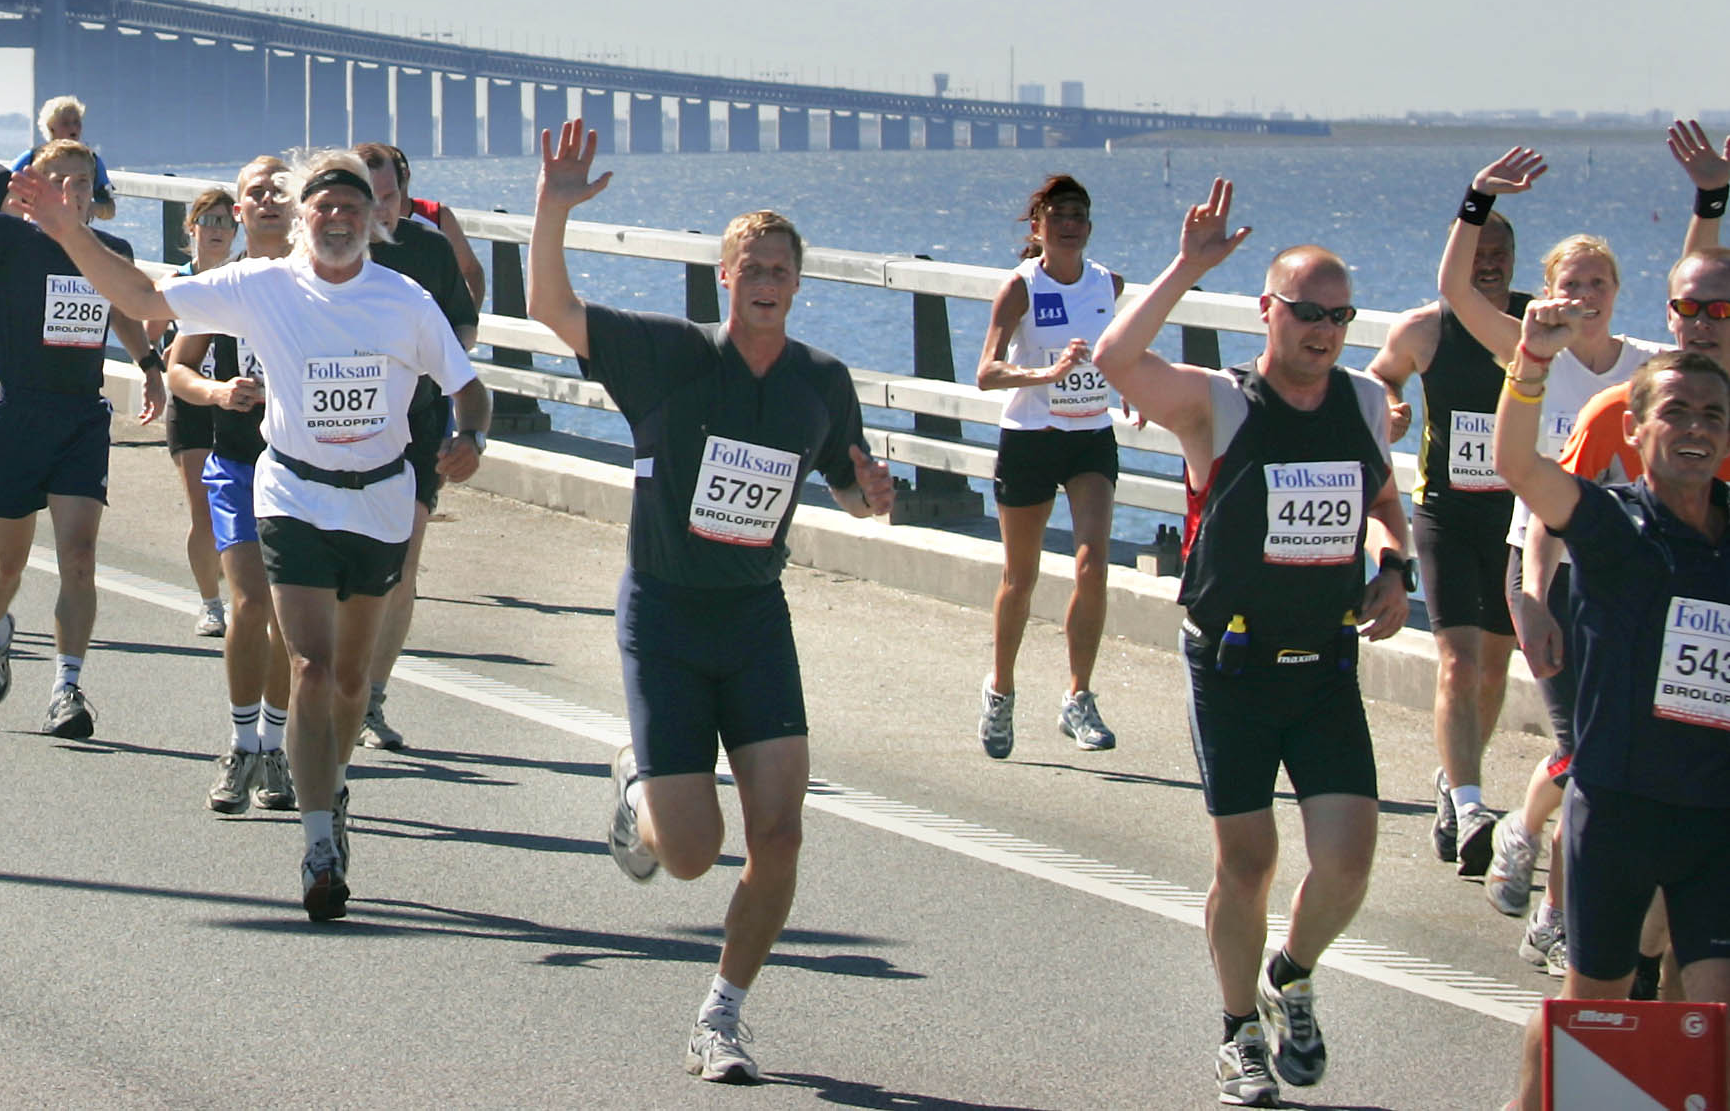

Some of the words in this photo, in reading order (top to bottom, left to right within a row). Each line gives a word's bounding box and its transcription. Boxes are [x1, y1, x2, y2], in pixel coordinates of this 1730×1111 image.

[51, 279, 99, 295] Folksa
[53, 301, 104, 322] 2286
[1037, 307, 1063, 320] SAS
[47, 325, 104, 334] BROLOPPET
[308, 362, 382, 380] Folksam
[313, 388, 378, 412] 3087
[307, 417, 386, 428] BROLOPPET
[1455, 415, 1495, 434] Folk
[709, 442, 792, 477] Folksam
[1458, 441, 1494, 462] 41
[1272, 468, 1356, 488] Folksam
[1452, 467, 1497, 477] BROLO
[707, 475, 783, 512] 5797
[695, 507, 777, 529] BROLOPPET
[1278, 500, 1352, 526] 4429
[1270, 535, 1357, 545] BROLOPPET
[1675, 603, 1730, 635] Folk
